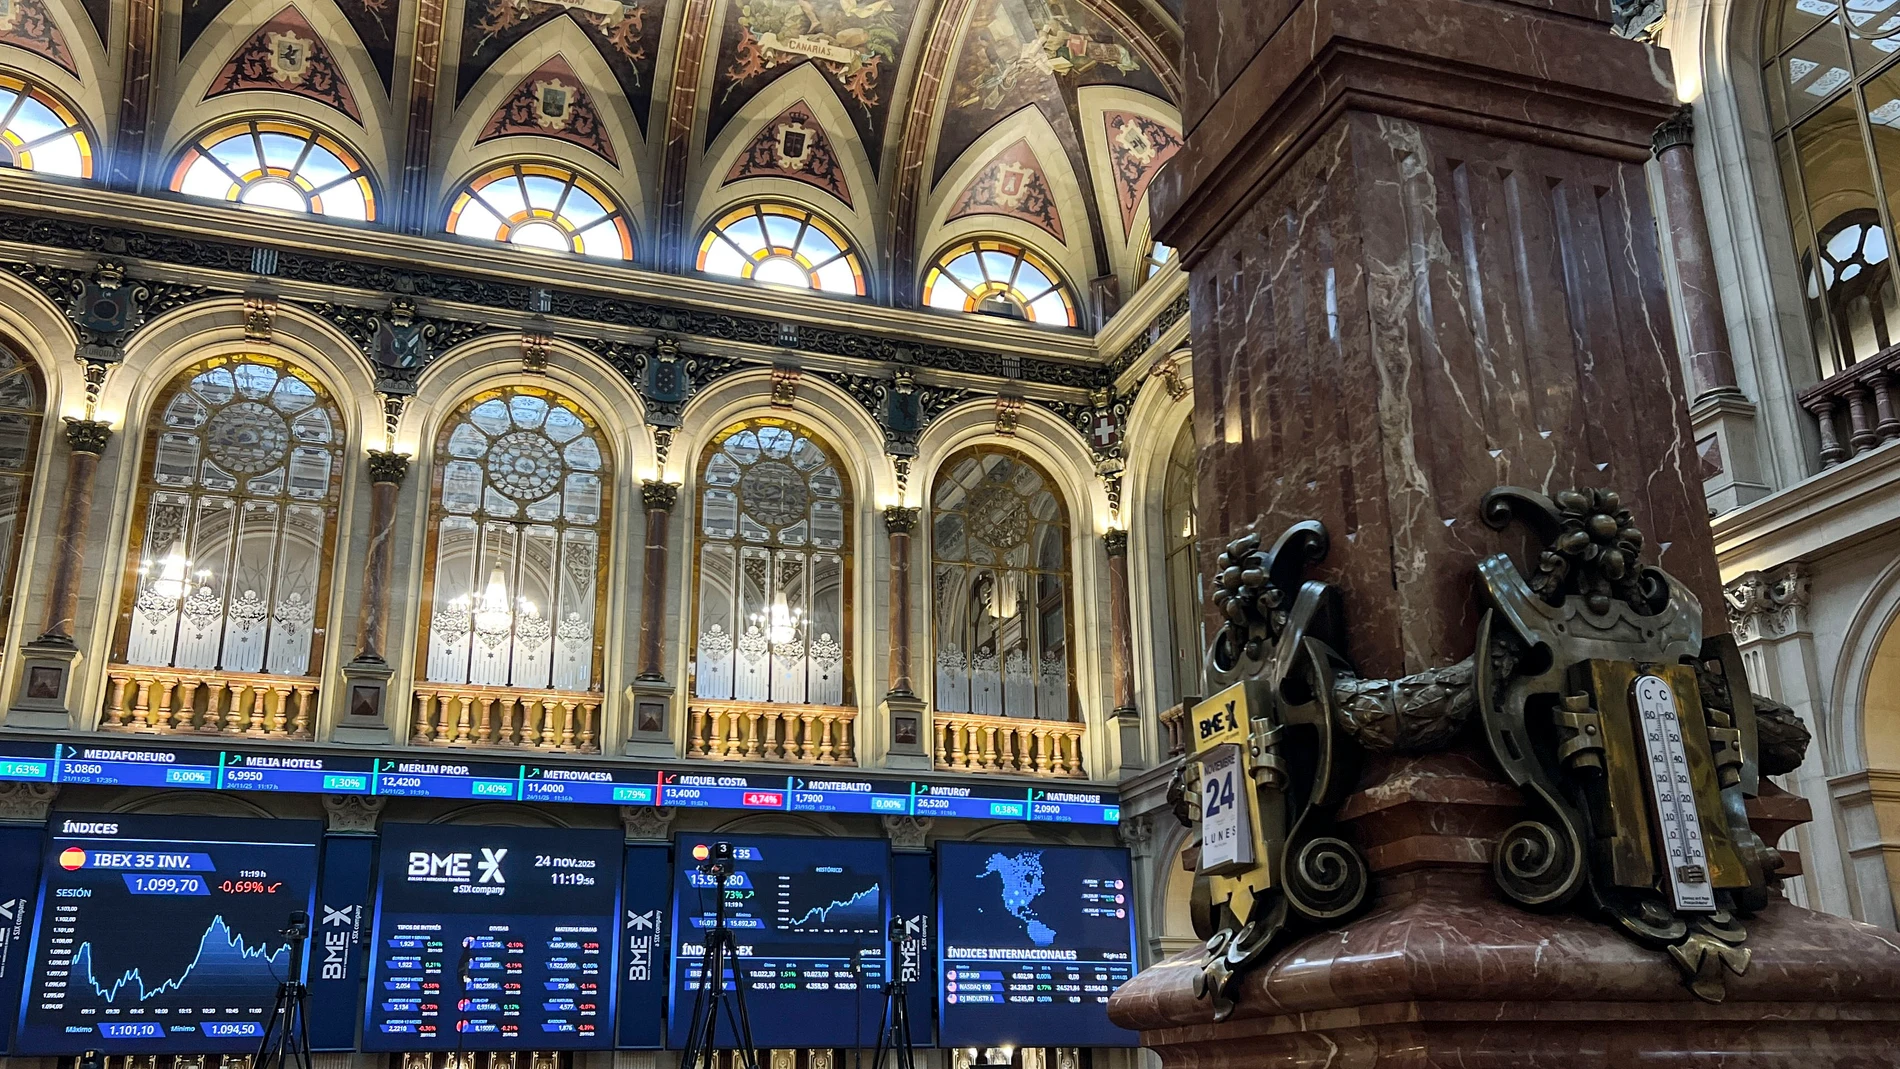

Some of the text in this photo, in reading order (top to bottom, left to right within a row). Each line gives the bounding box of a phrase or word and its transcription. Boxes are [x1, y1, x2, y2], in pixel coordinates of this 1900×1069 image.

[1644, 710, 1675, 720] 60 60
[1649, 733, 1679, 742] 50 50
[84, 749, 176, 763] MEDIAFOREURO
[1653, 754, 1683, 763] 40 40
[246, 757, 323, 769] MELIA HOTELS
[398, 763, 470, 775] MERLIN PROP.
[6, 764, 40, 775] 1,63%
[64, 763, 205, 782] 3,0860 0,00%
[228, 770, 360, 788] 6,9950 1,30%
[543, 770, 613, 782] METROVACESA
[680, 775, 747, 787] MIQUEL COSTA
[1657, 774, 1687, 783] 30 30
[382, 777, 507, 794] 12,4200 0,40%
[527, 783, 646, 800] 11,4000 1,79%
[808, 781, 872, 792] MONTEBALITO
[930, 786, 971, 797] NATURGY
[665, 789, 778, 804] 13,4000 -0,74%
[1047, 792, 1101, 804] NATURHOUSE
[1206, 771, 1235, 818] 24
[1681, 794, 1691, 802] 20
[795, 793, 901, 809] 1,7900 0,00%
[917, 799, 1018, 815] 26,5200 0,38%
[1034, 804, 1060, 814] 2,0900
[1666, 813, 1675, 821] 10
[62, 819, 119, 834] ÍNDICES
[1204, 825, 1237, 846] LUNES
[1671, 831, 1696, 839] 0 0
[720, 844, 727, 853] 3
[738, 850, 751, 859] 35
[1672, 849, 1700, 857] 10 10
[93, 853, 191, 868] IBEX 35 INV.
[408, 852, 472, 876] BME
[535, 855, 550, 867] 24
[240, 870, 260, 878] 11:19
[135, 878, 264, 894] 1.099,70 -0,69%
[459, 885, 472, 893] SIX
[472, 886, 505, 895] company
[56, 887, 92, 898] SESIÓN
[724, 890, 743, 899] 73%
[322, 931, 345, 979] BME
[629, 936, 648, 981] BME
[947, 946, 1077, 960] ÍNDICES INTERNACIONALES
[109, 1025, 155, 1036] 1.101,10
[211, 1024, 255, 1035] 1.094,50
